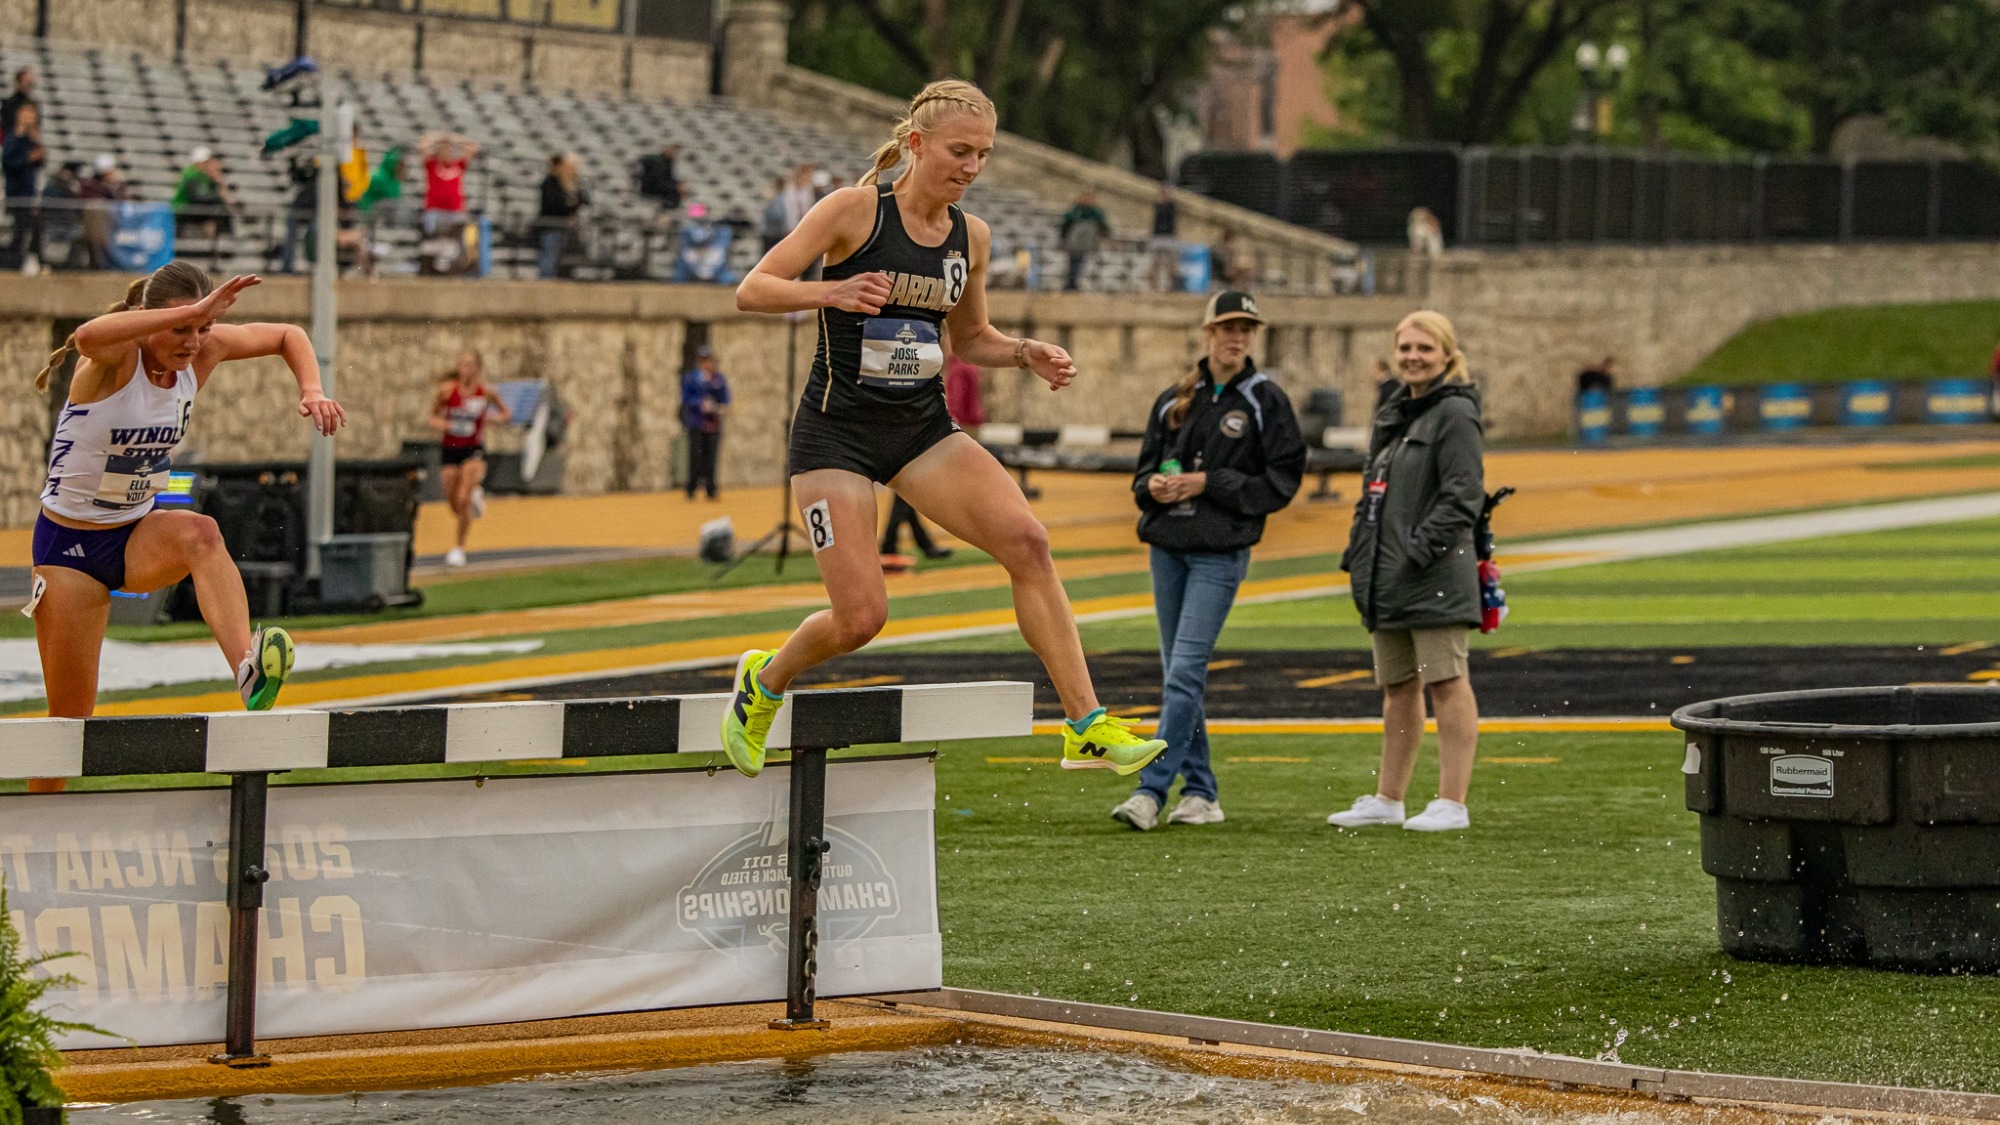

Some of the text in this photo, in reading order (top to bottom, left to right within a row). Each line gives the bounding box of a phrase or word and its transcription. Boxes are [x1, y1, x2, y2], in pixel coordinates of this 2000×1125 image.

[950, 263, 962, 304] 8
[891, 347, 919, 360] JOSIE
[888, 362, 920, 375] PARKS
[123, 447, 171, 458] STATE
[130, 480, 151, 491] ELLA
[810, 508, 827, 549] 8
[1776, 766, 1828, 776] Rubbermaid
[1773, 786, 1831, 795] Commercial Products
